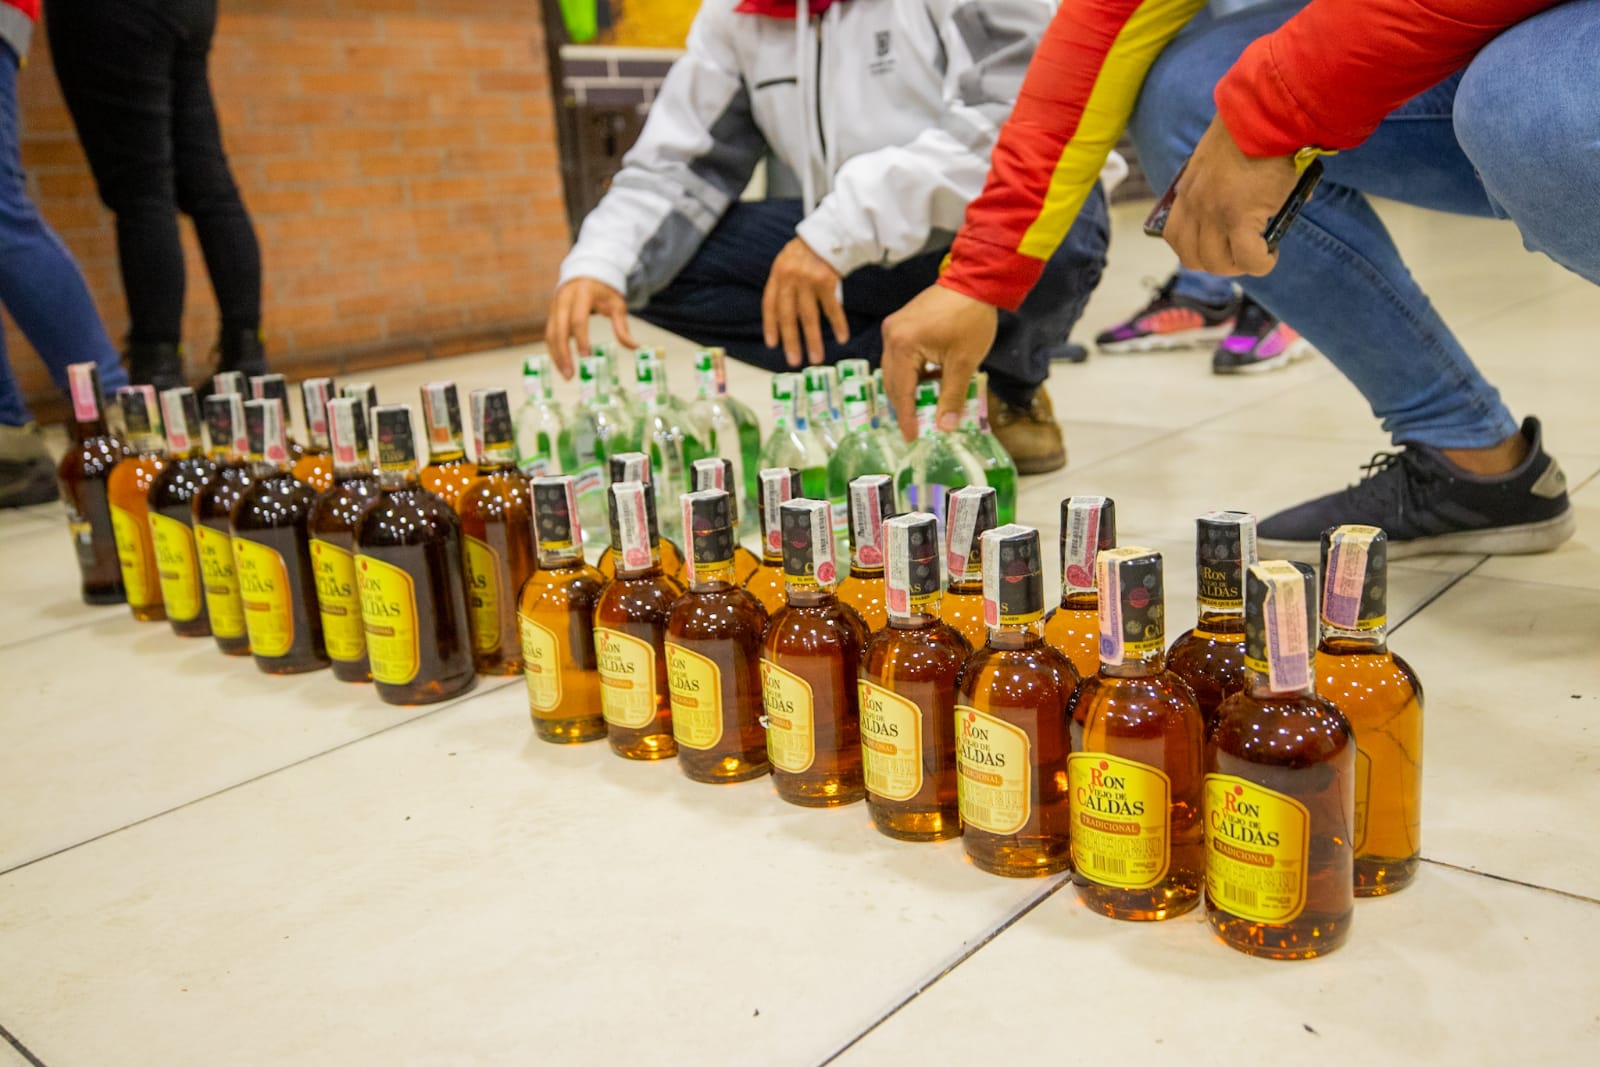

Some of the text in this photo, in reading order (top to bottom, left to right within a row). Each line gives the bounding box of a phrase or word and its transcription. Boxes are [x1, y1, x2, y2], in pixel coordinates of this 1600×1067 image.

[1203, 566, 1226, 580] RON
[1200, 584, 1239, 598] ALDAS
[861, 715, 900, 738] ALDAS
[962, 717, 989, 741] RON
[1089, 767, 1125, 790] RON
[1076, 786, 1145, 816] CALDAS
[1088, 783, 1127, 800] VIEJO DE
[1223, 790, 1260, 818] RON
[1081, 814, 1138, 833] TRADICIONAL
[1211, 810, 1280, 847] CALDAS
[1221, 807, 1260, 829] VIEJO DE
[1215, 839, 1271, 865] TRADICIONAL
